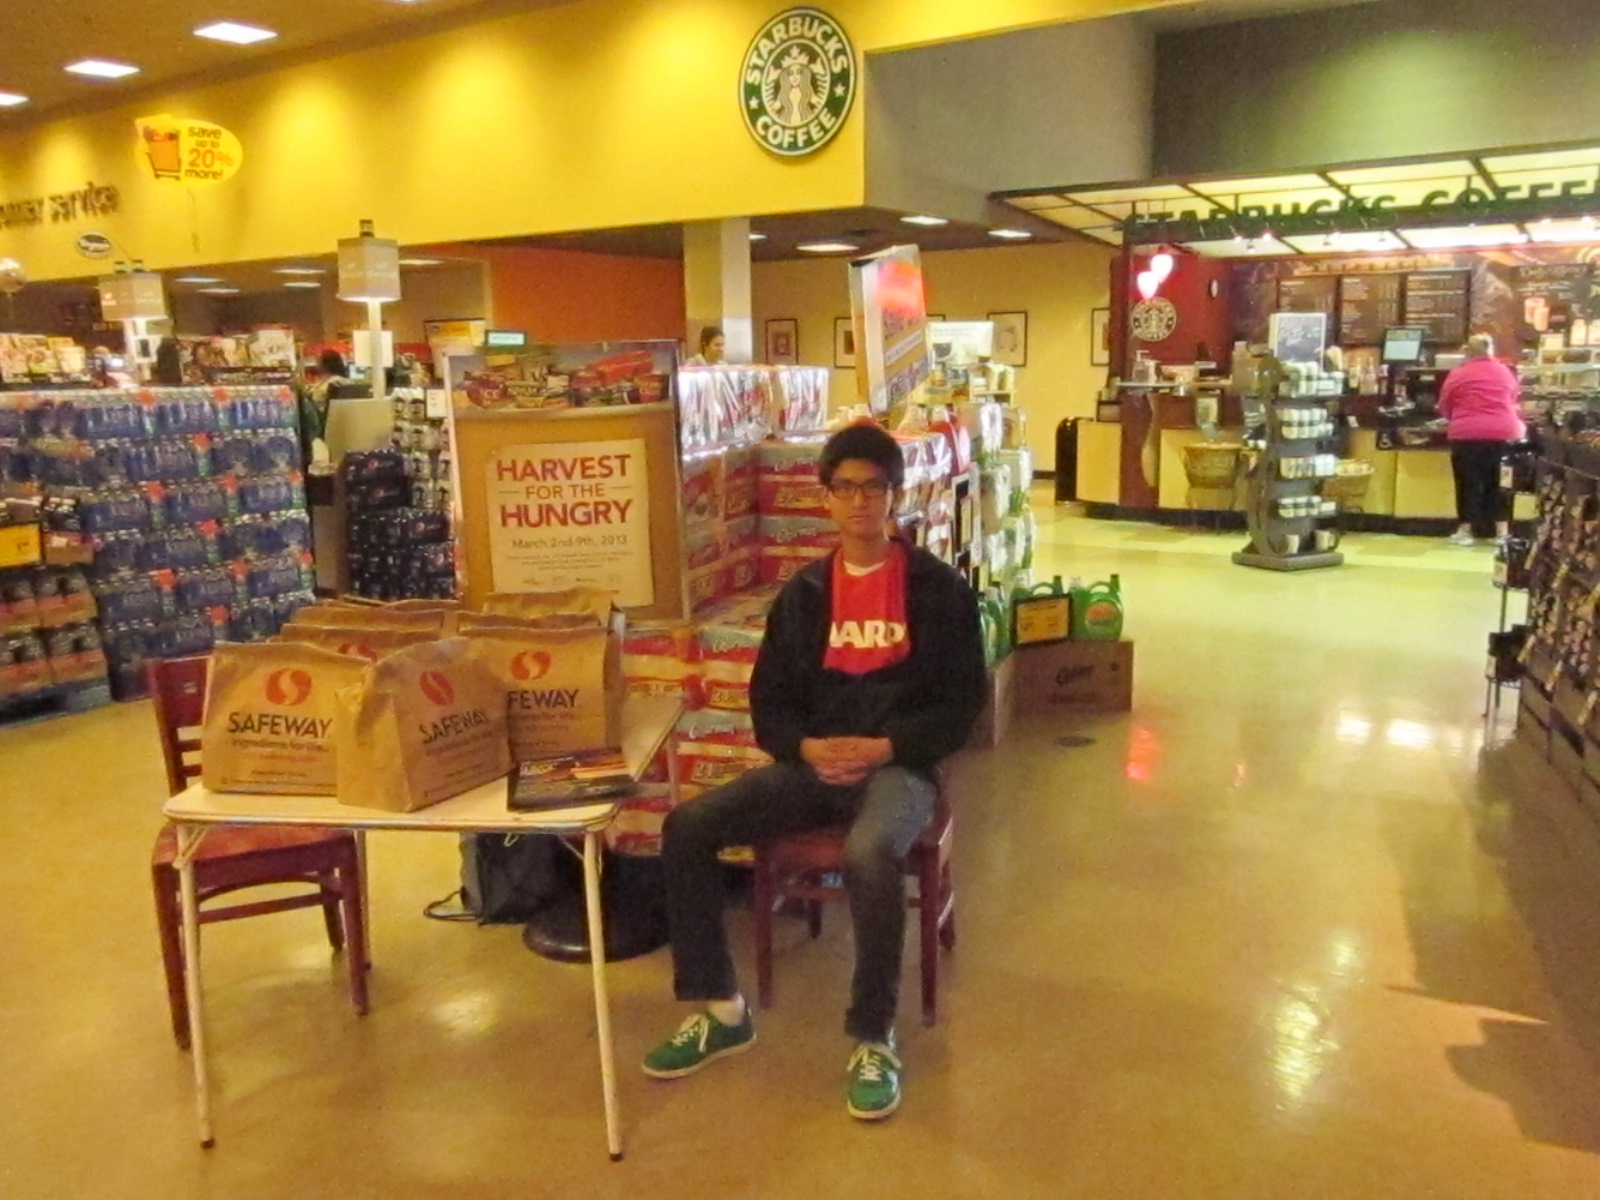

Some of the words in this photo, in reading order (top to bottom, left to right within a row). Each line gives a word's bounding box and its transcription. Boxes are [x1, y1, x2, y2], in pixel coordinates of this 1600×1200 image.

[746, 16, 848, 85] STARBUCKS
[187, 126, 222, 139] save
[756, 108, 836, 148] COFFEE
[188, 148, 234, 168] 20%
[184, 169, 224, 180] more!
[496, 454, 631, 481] HARVEST
[526, 485, 564, 500] FOR
[569, 483, 606, 498] THE
[500, 499, 633, 528] HUNGRY
[512, 537, 548, 549] March
[601, 535, 628, 546] 2013
[507, 688, 579, 711] FEWAY
[228, 711, 333, 739] SAFEWAY
[419, 708, 490, 745] SAFEWAY
